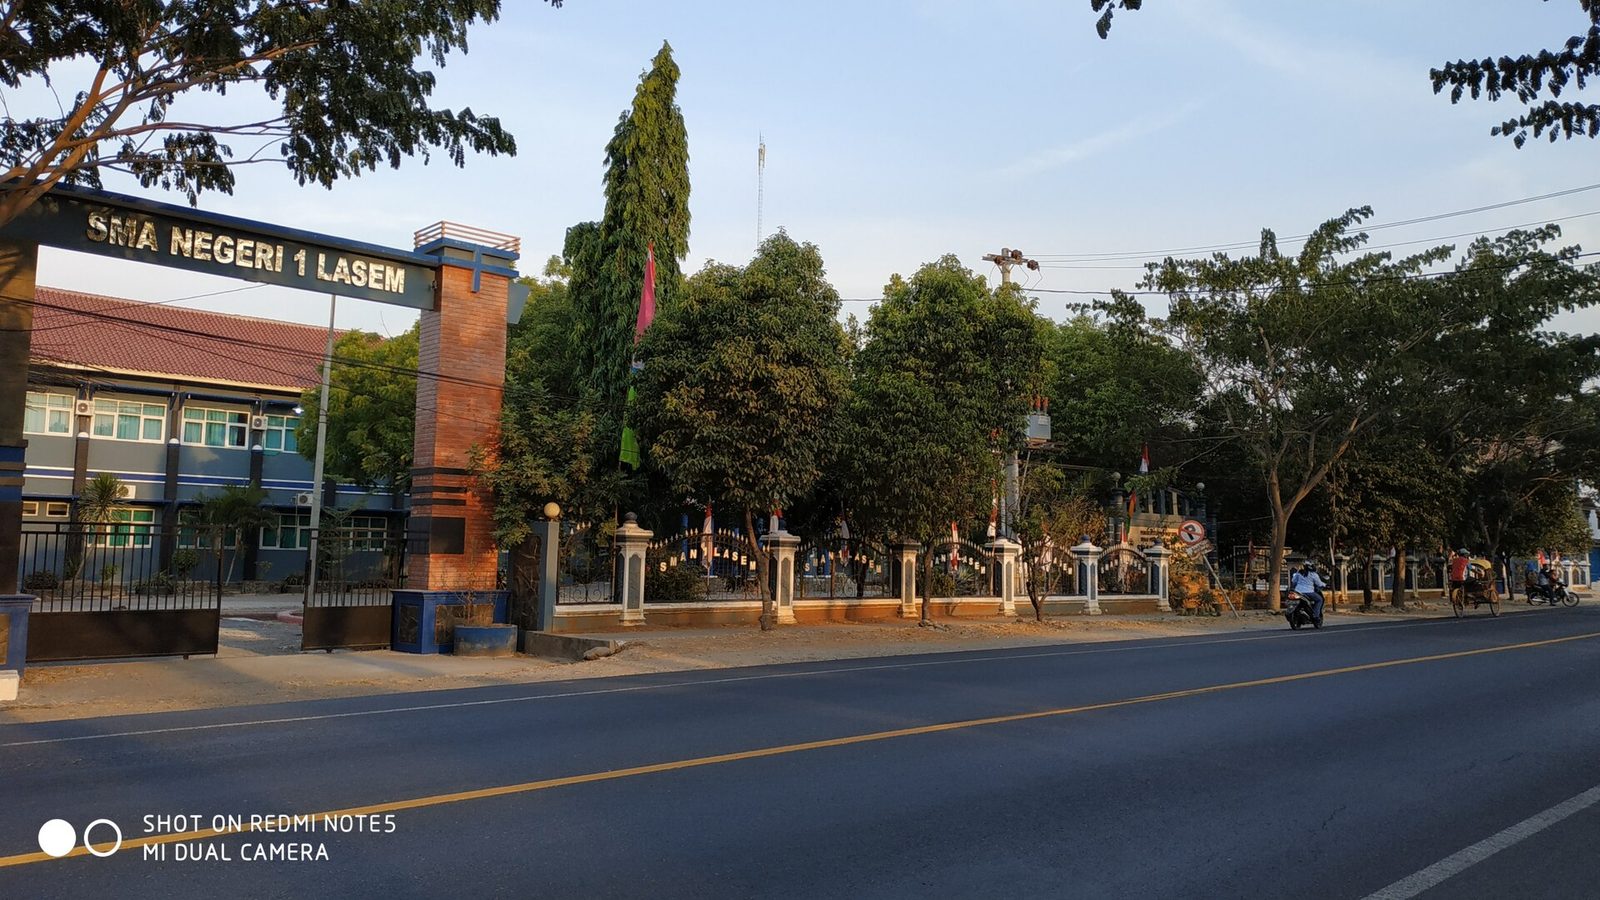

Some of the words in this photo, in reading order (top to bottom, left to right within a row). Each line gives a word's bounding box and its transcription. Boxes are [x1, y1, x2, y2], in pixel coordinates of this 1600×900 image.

[86, 210, 159, 252] SMA
[170, 225, 284, 273] NEGERI
[293, 248, 307, 277] 1
[316, 252, 406, 294] LASEM
[713, 546, 757, 571] LASEM
